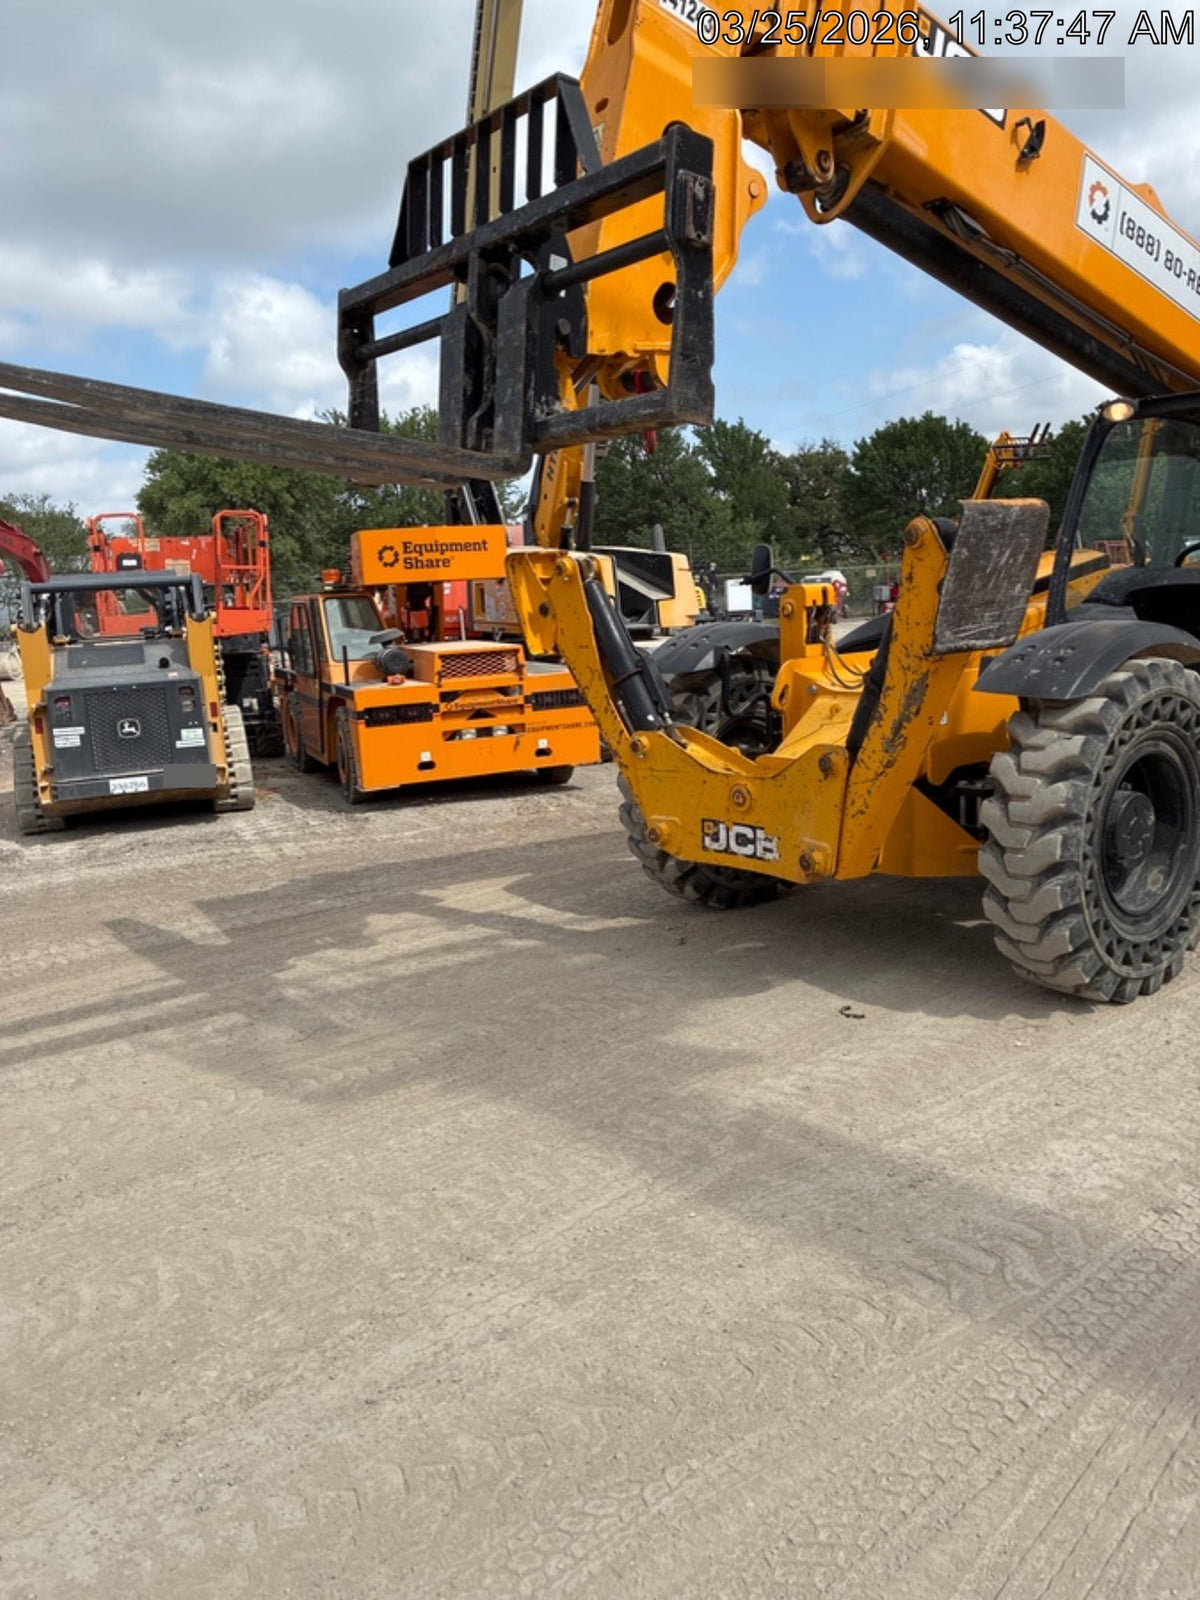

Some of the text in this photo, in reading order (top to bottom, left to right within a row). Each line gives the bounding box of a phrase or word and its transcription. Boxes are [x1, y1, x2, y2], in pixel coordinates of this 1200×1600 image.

[1119, 211, 1161, 262] (888)
[402, 540, 488, 556] Equipment
[403, 556, 451, 569] Share
[703, 821, 780, 860] JCB
